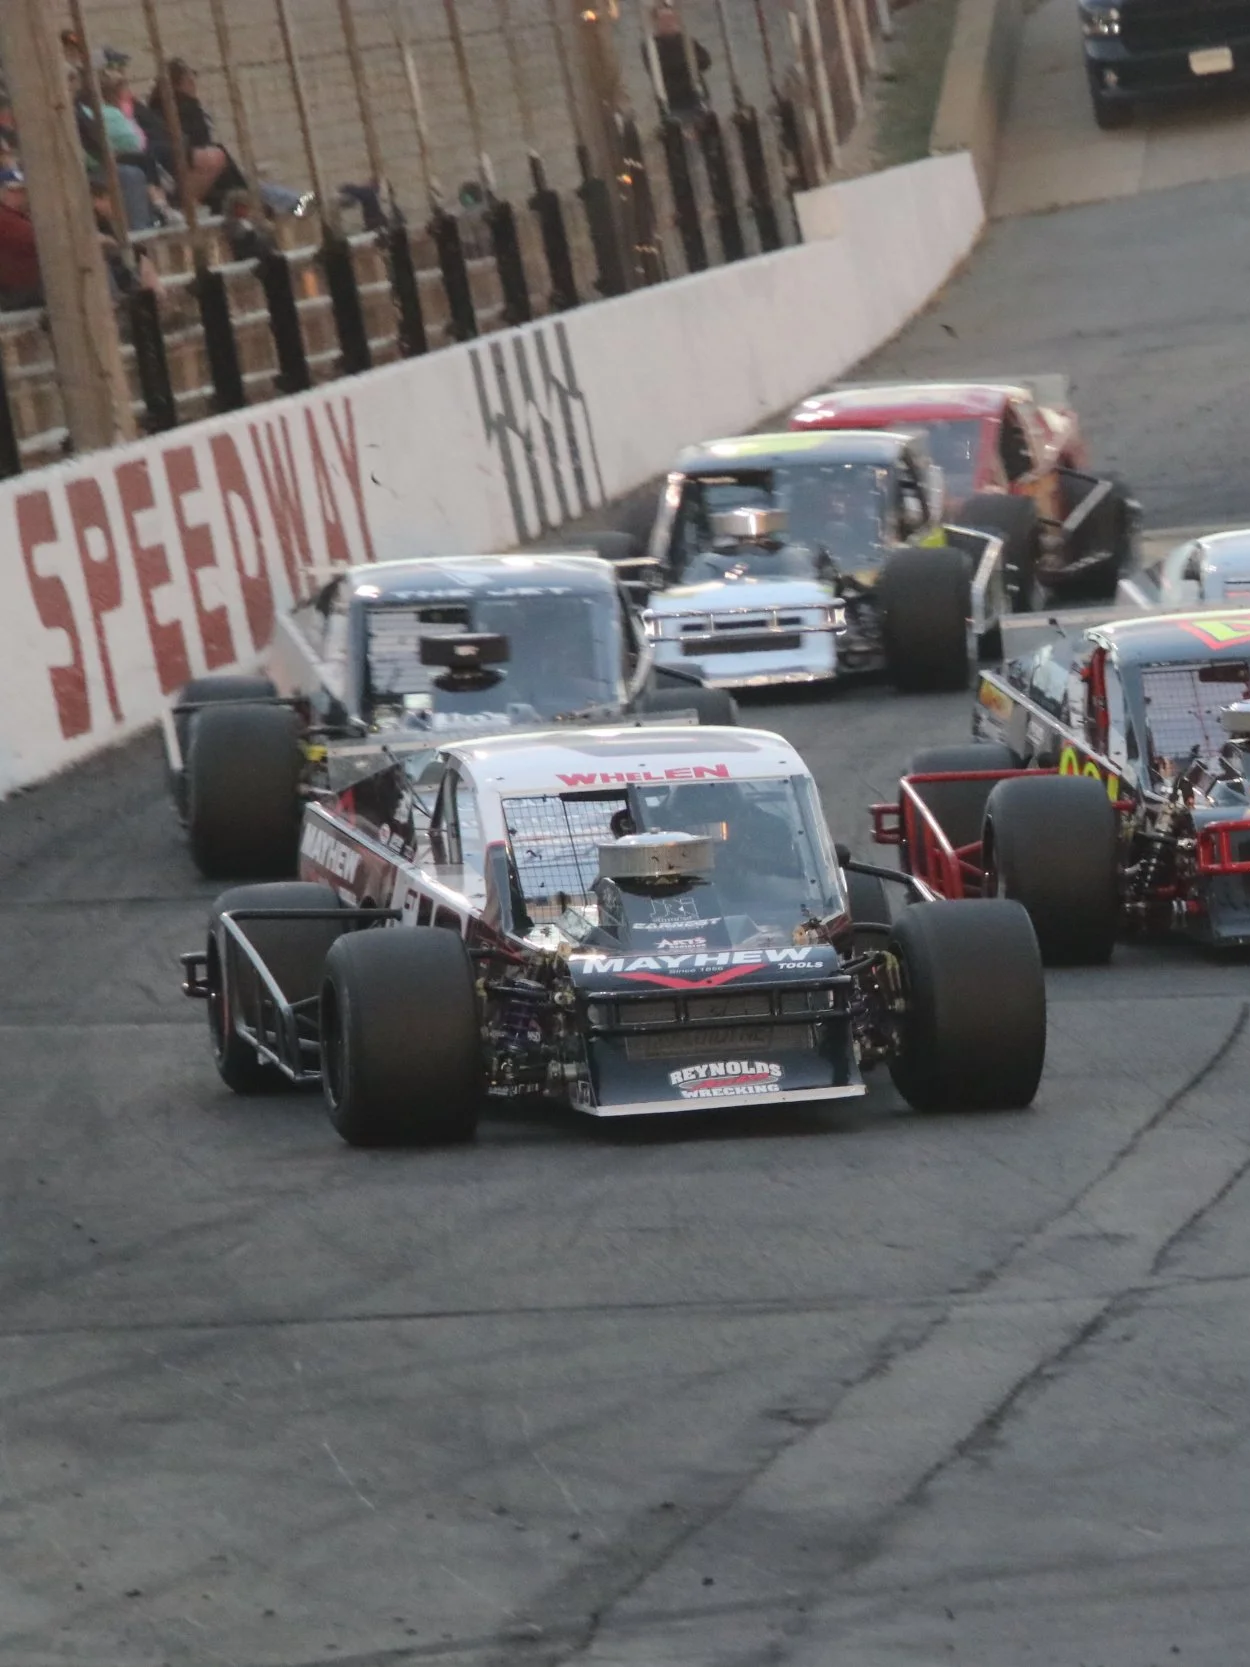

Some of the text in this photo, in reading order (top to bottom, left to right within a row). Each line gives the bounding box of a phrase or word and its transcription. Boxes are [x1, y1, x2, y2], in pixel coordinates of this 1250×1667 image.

[16, 396, 375, 740] SPEEDWAY
[556, 763, 731, 786] WHELEN
[301, 822, 361, 884] MAYHEW
[582, 946, 813, 974] MAYHEW
[777, 960, 824, 970] TOOLS
[671, 1061, 783, 1085] REYNOLDS
[681, 1084, 780, 1098] WRECKING
